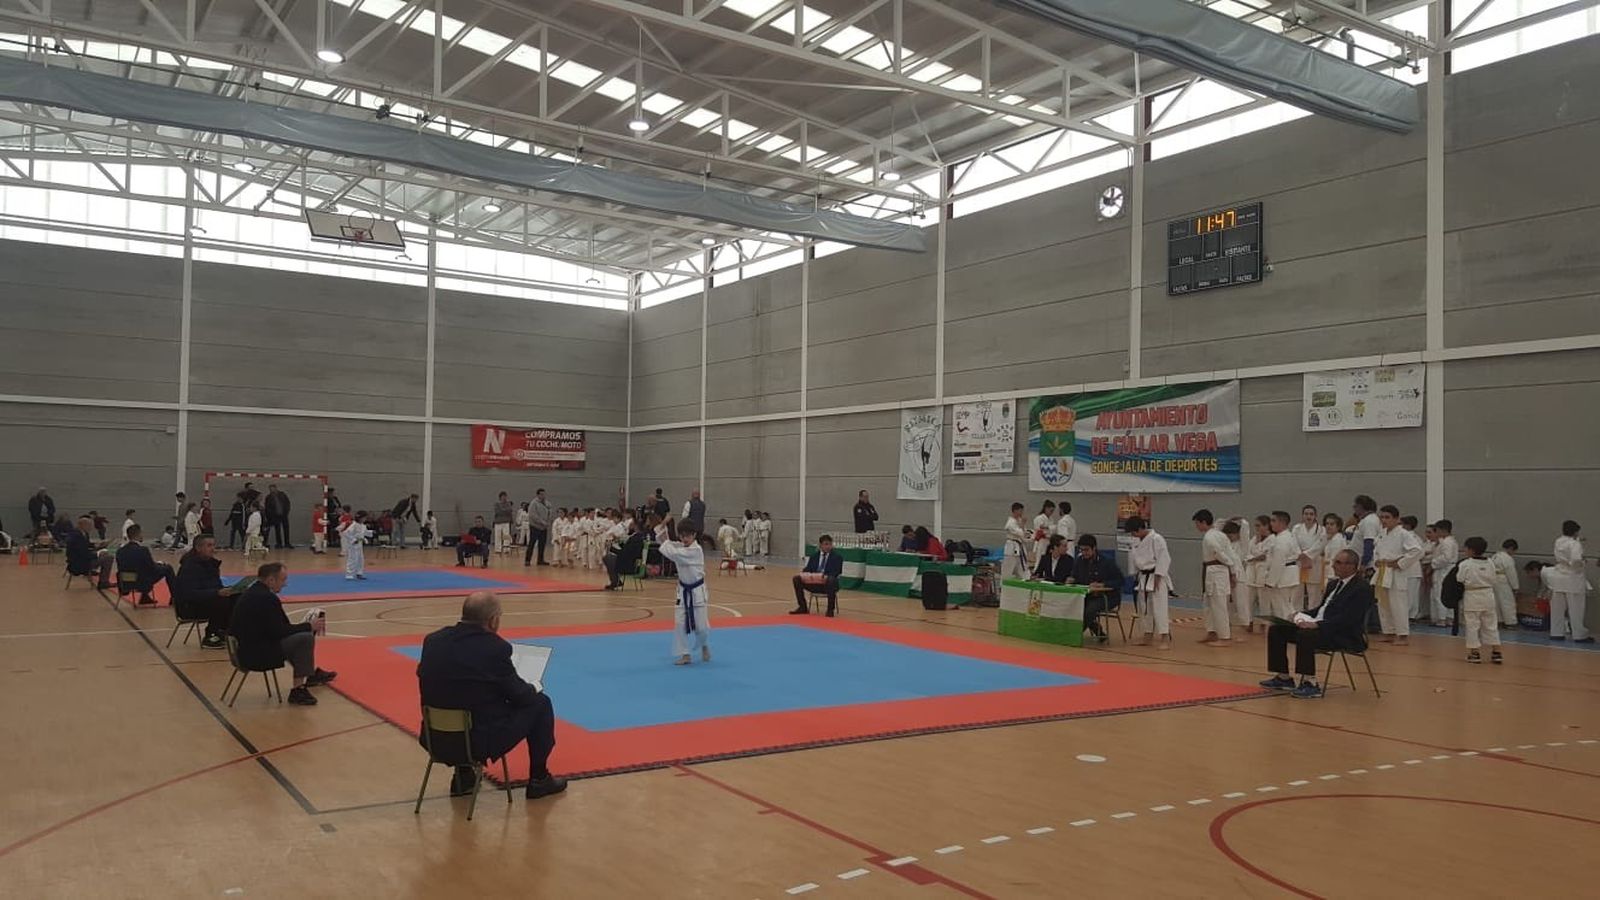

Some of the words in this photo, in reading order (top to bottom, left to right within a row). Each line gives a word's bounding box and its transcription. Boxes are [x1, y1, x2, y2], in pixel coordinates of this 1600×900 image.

[1197, 210, 1236, 235] 11:47
[1096, 403, 1208, 431] AYUNTAMIENTO
[483, 428, 506, 454] N
[525, 430, 582, 441] COMPRAMOS
[526, 440, 536, 448] TU
[1091, 437, 1109, 456] DE
[1174, 431, 1218, 453] VEGA
[1150, 458, 1162, 472] DE
[1164, 458, 1218, 472] DEPORTES
